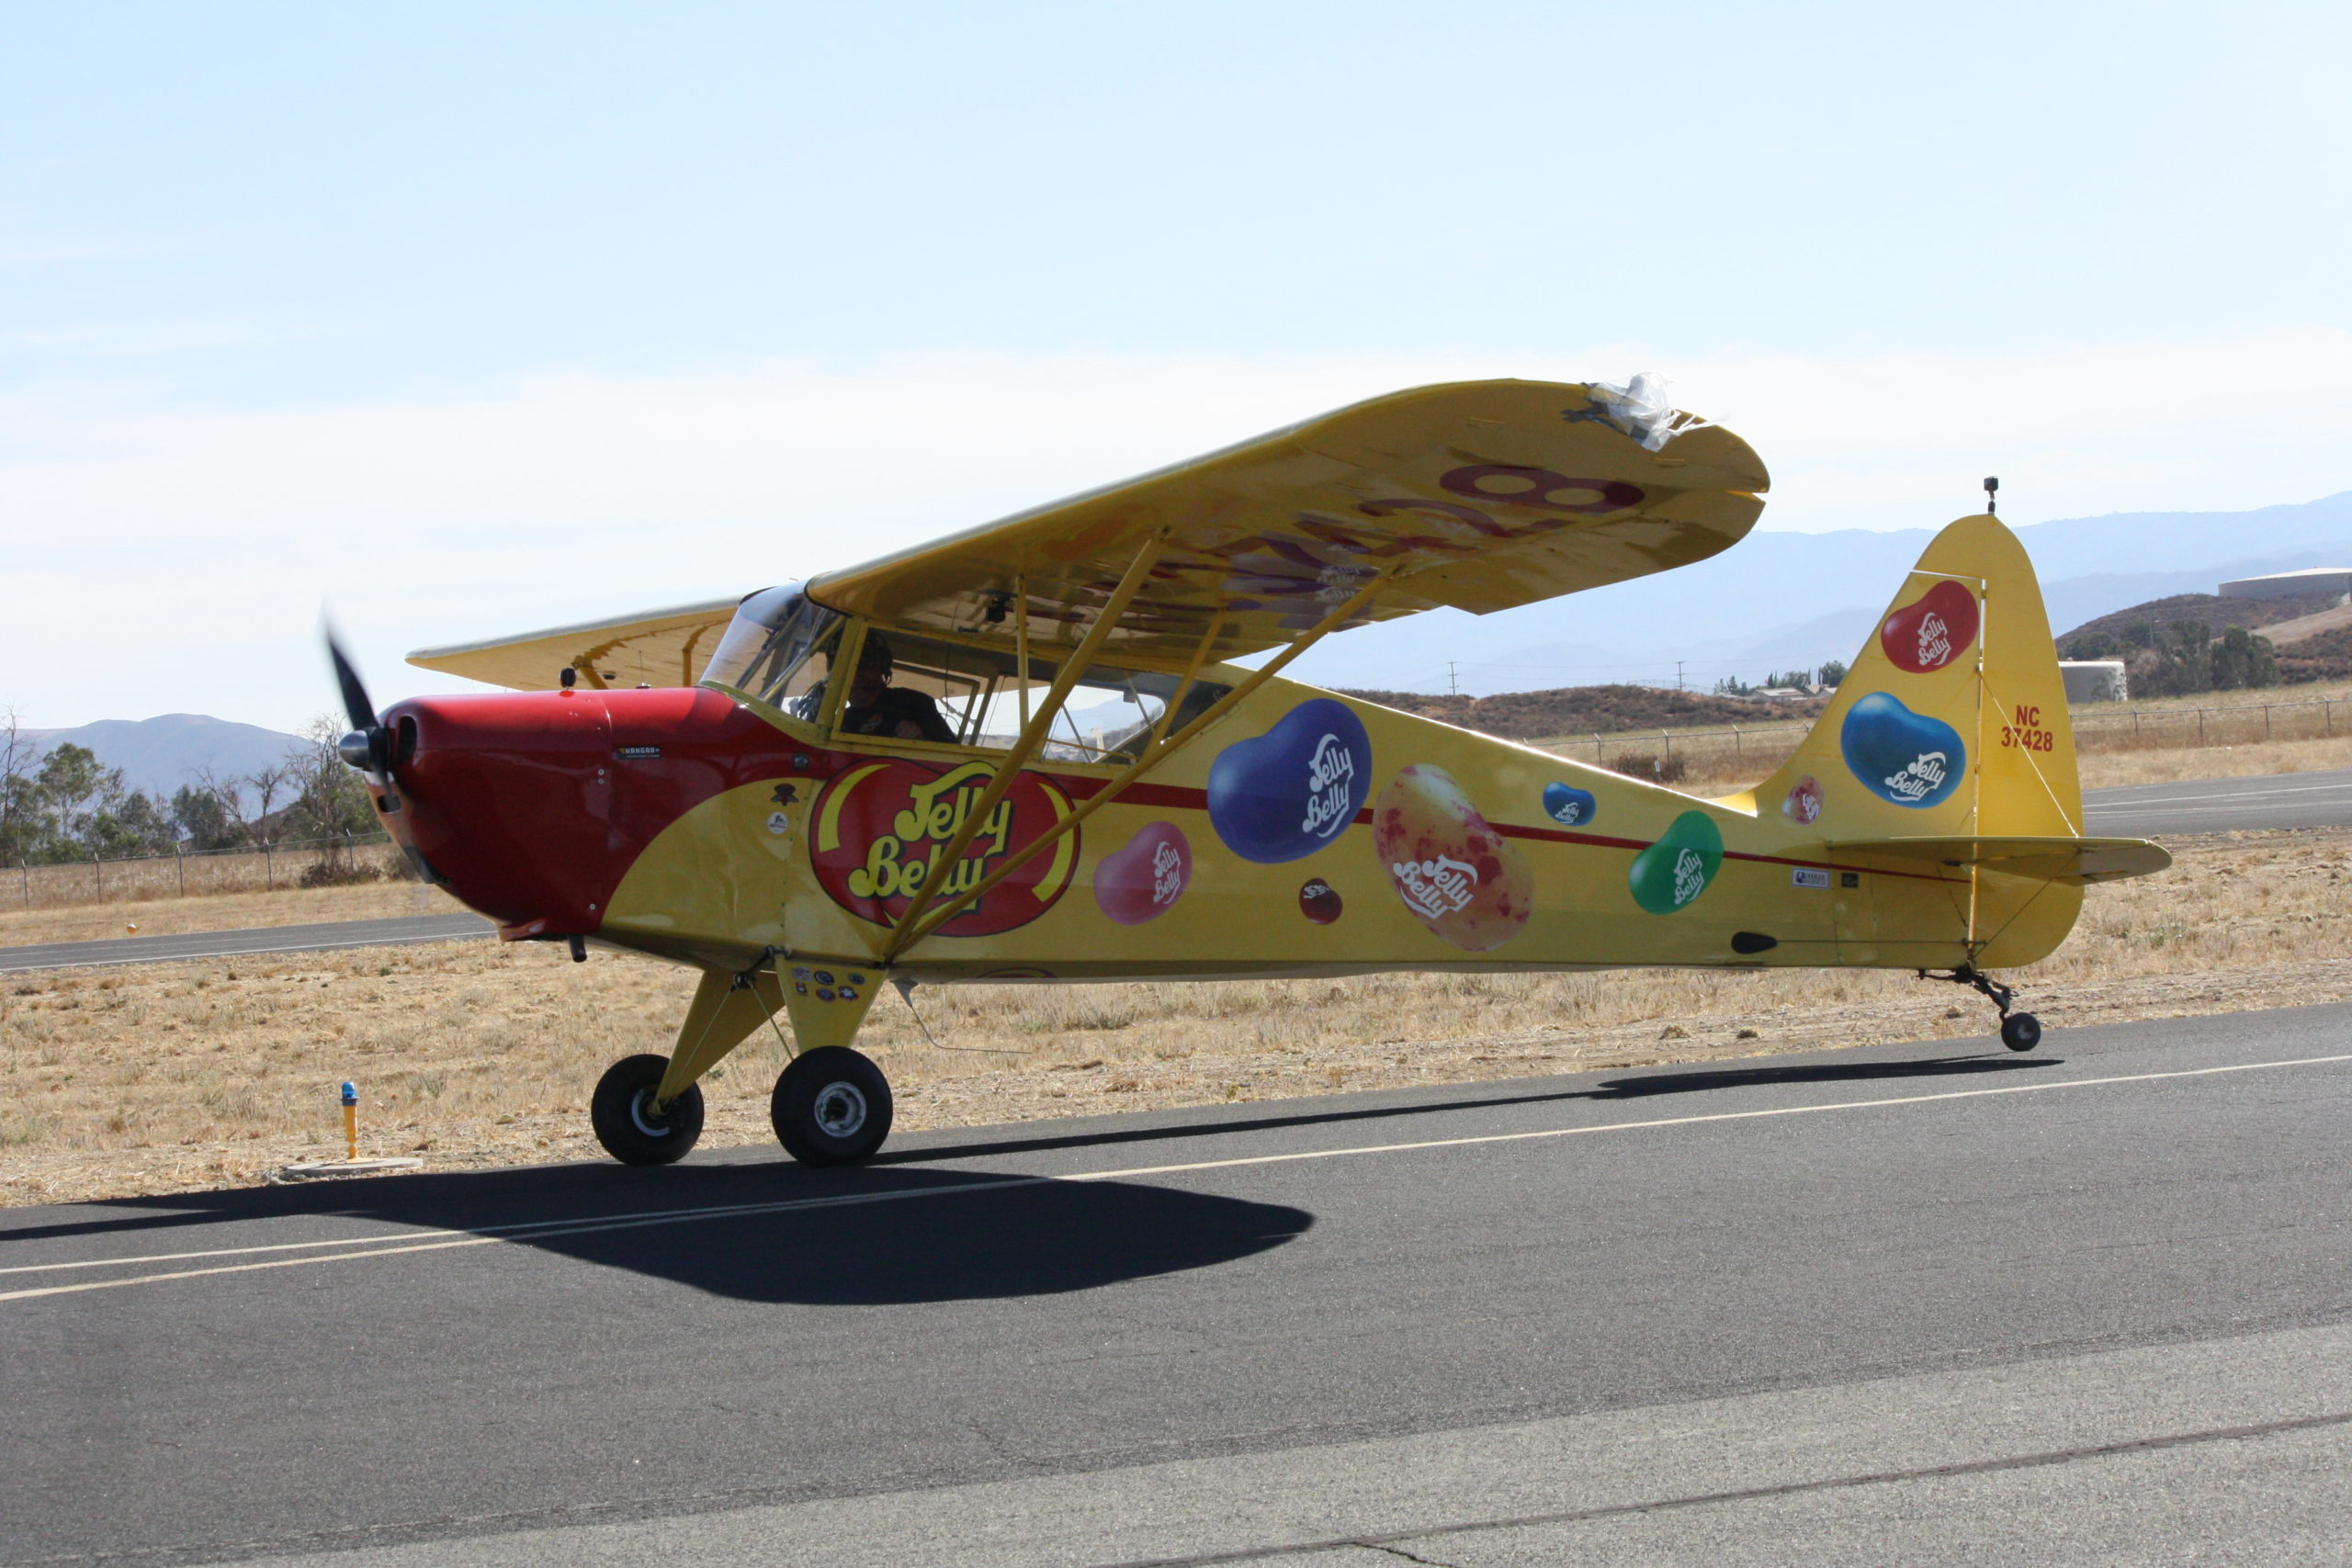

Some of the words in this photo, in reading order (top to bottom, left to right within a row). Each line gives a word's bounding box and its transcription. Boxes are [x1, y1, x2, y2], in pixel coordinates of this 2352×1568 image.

[1917, 612, 1949, 647] Jelly
[1917, 637, 1951, 666] Belly
[2016, 705, 2040, 728] NC
[2001, 726, 2053, 752] 37428
[1307, 733, 1354, 792] Jelly
[1907, 751, 1946, 790] Jelly
[1884, 771, 1929, 801] Belly
[1302, 783, 1350, 838] Belly
[1562, 802, 1579, 818] Jelly
[1152, 840, 1181, 877] Jelly
[1673, 848, 1702, 886] Jelly
[1153, 868, 1181, 904] Belly
[1393, 862, 1449, 919] Belly
[1421, 854, 1478, 912] Jelly
[1674, 871, 1705, 905] Belly
